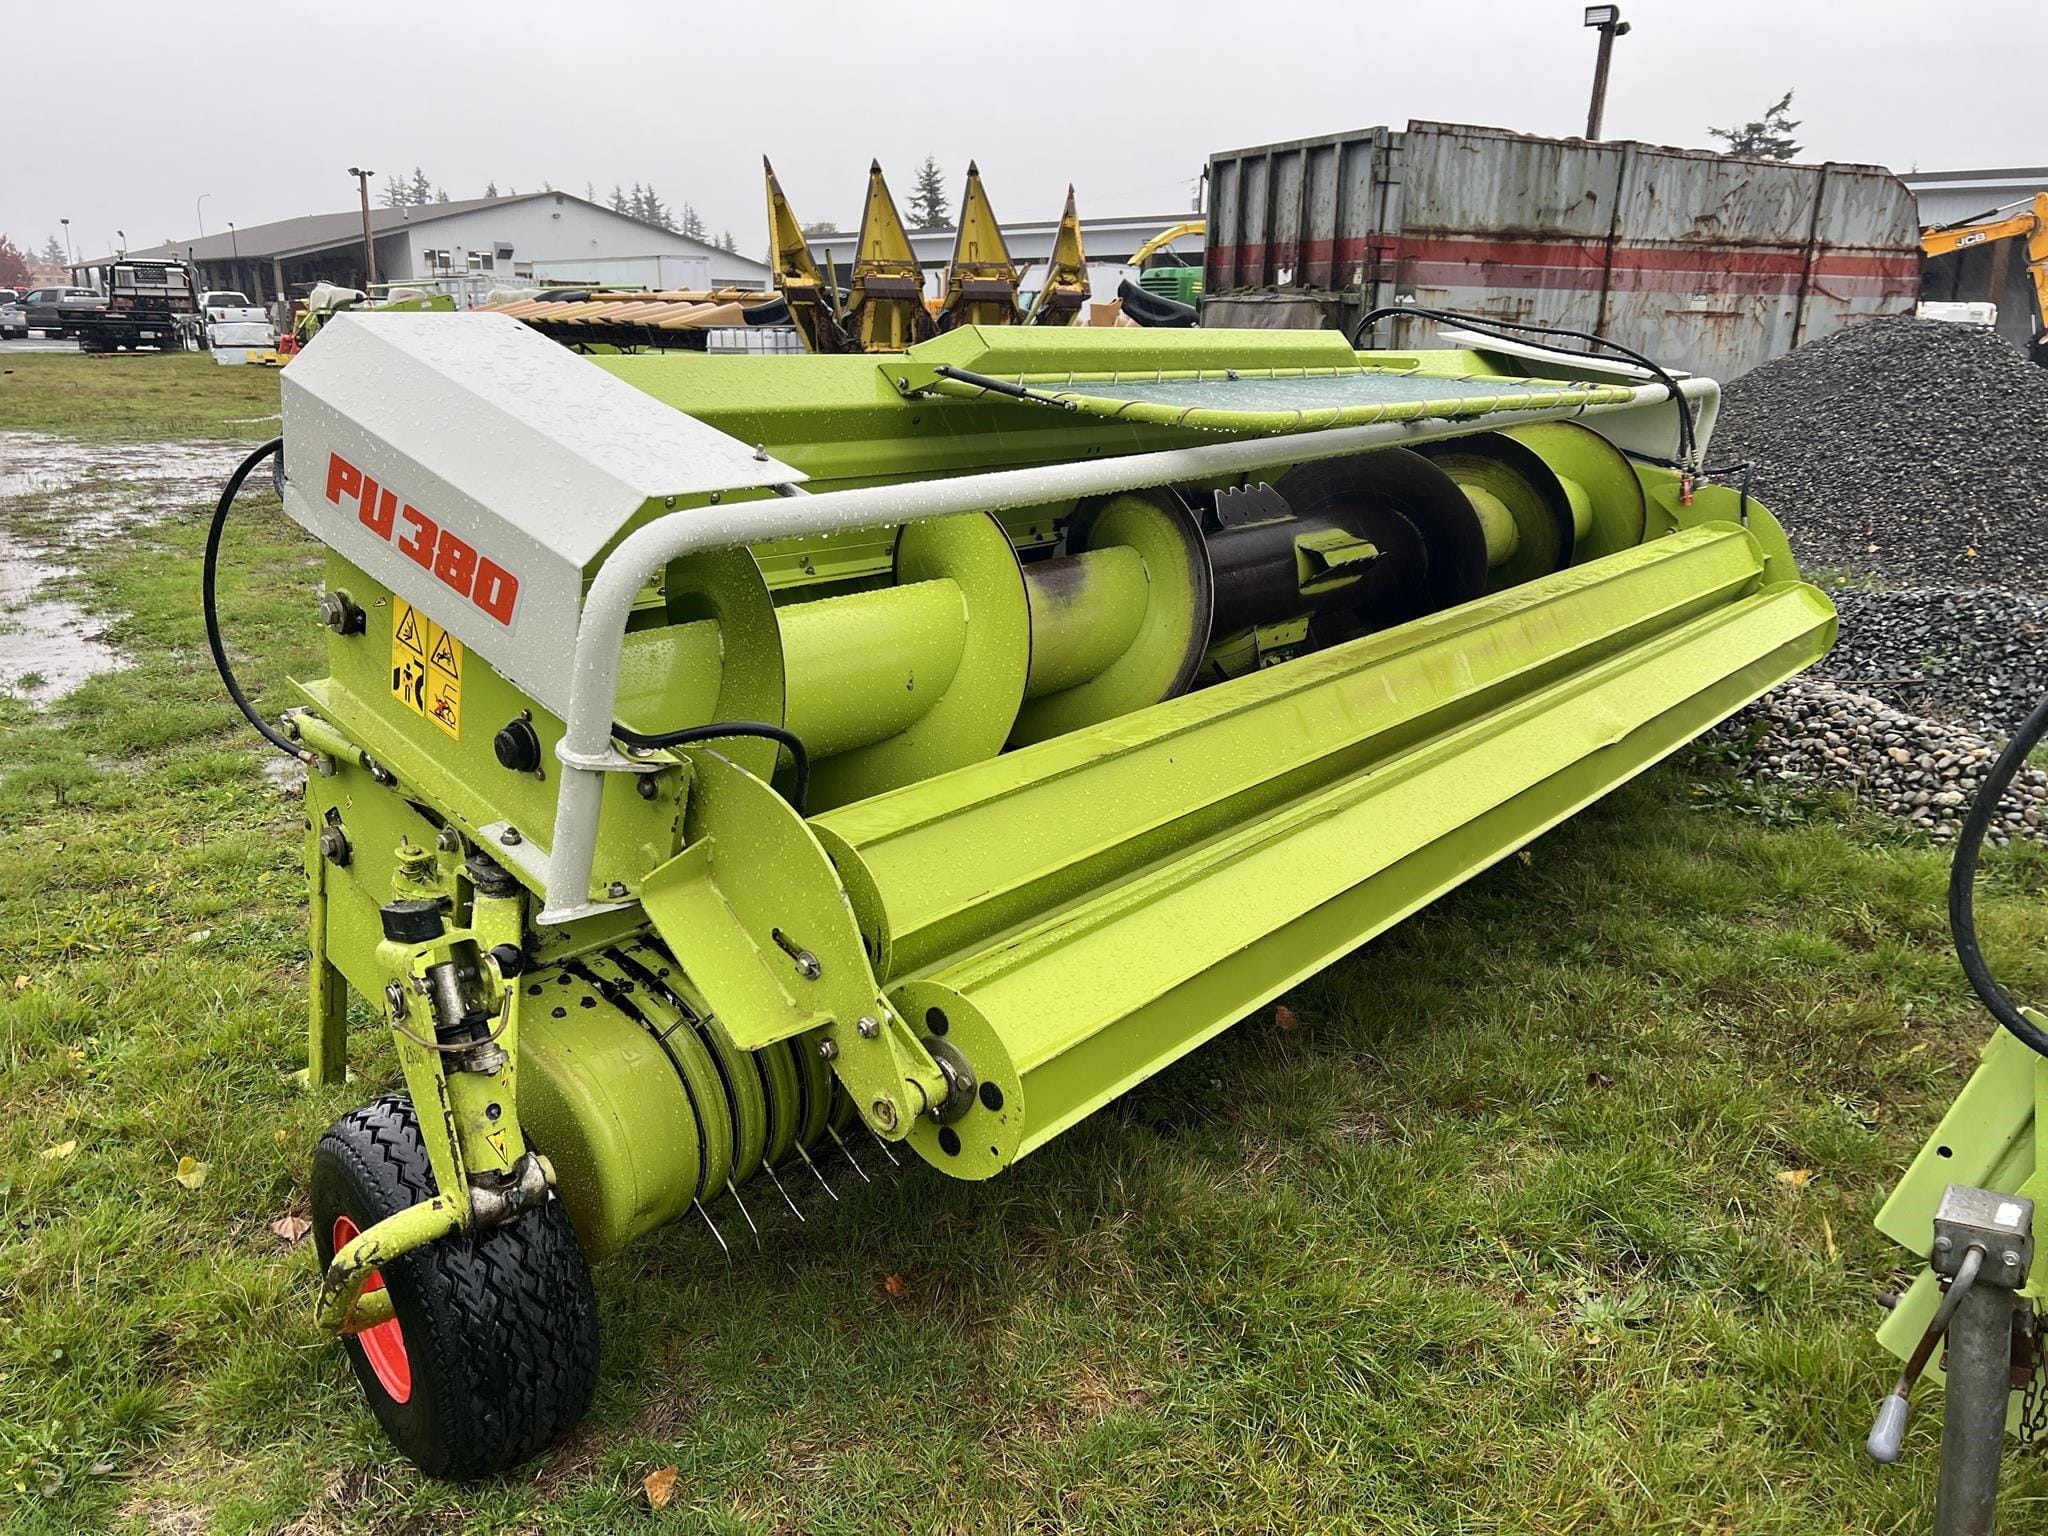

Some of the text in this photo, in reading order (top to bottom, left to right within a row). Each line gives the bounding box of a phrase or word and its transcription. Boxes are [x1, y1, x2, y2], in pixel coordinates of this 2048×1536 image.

[1956, 232, 1986, 247] JCB
[326, 452, 518, 627] PU 380
